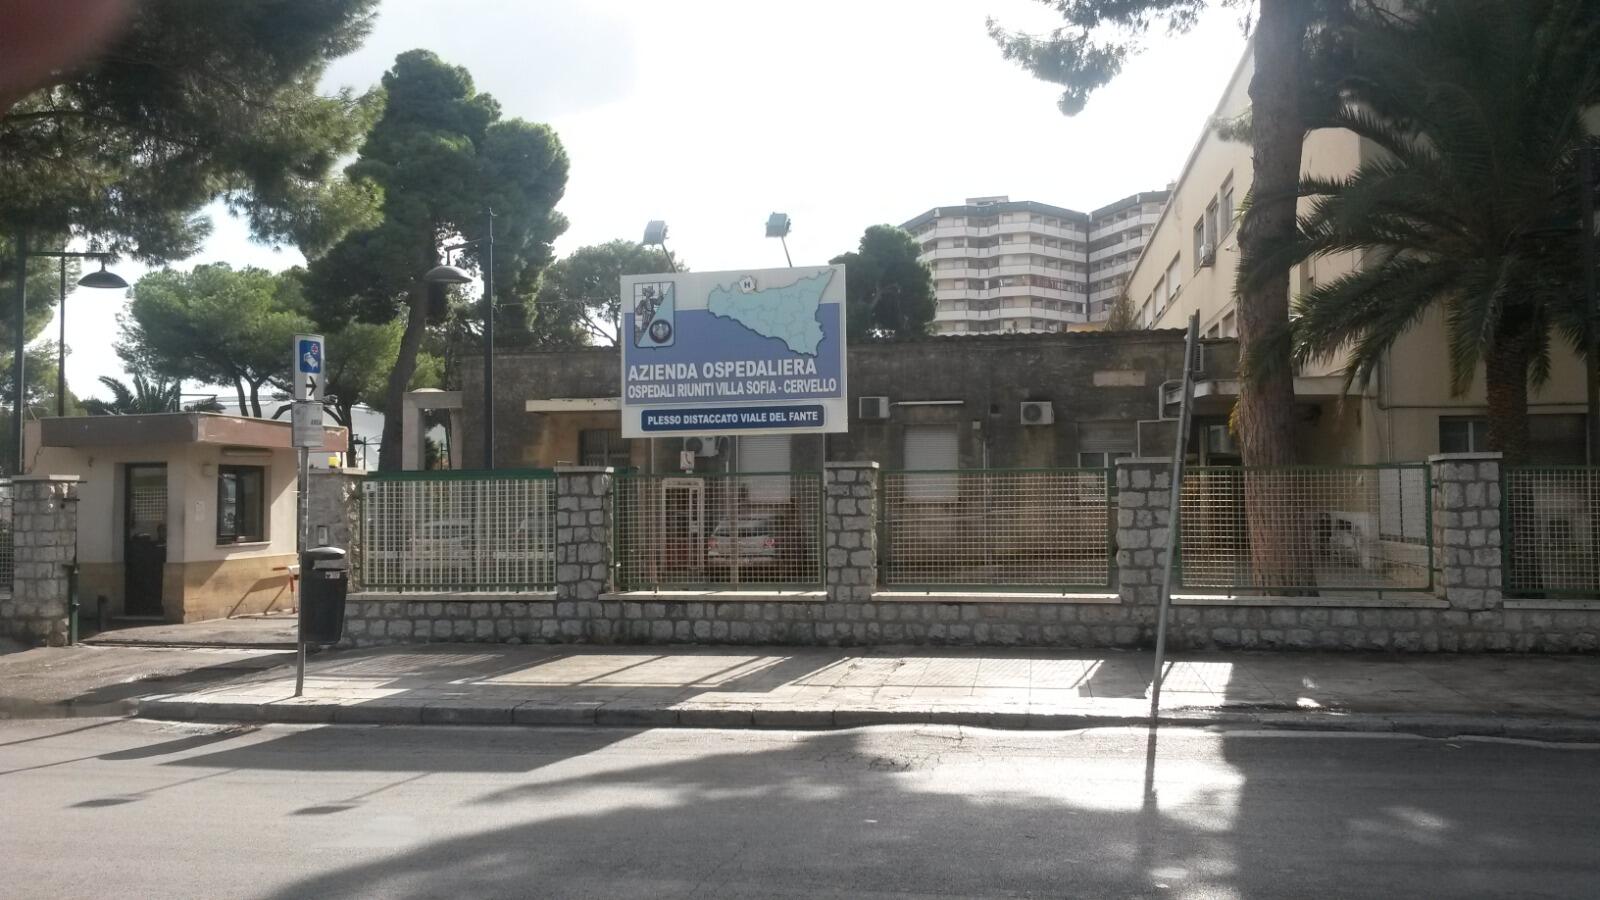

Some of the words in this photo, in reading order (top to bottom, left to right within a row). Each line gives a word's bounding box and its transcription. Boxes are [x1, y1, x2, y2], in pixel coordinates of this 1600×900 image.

[628, 362, 698, 381] AZIENDA
[702, 358, 817, 379] OSPEDALIERA
[628, 384, 675, 398] OSPEDALI
[677, 382, 714, 397] RIUNITI
[716, 381, 744, 396] VILLA
[746, 380, 777, 394] SOFIA
[783, 378, 837, 393] CERVELLO
[647, 415, 681, 425] PLESSO
[683, 413, 738, 424] DISTACCATO
[740, 412, 767, 423] VIALE
[769, 412, 787, 422] DEL
[789, 411, 818, 421] FANTE
